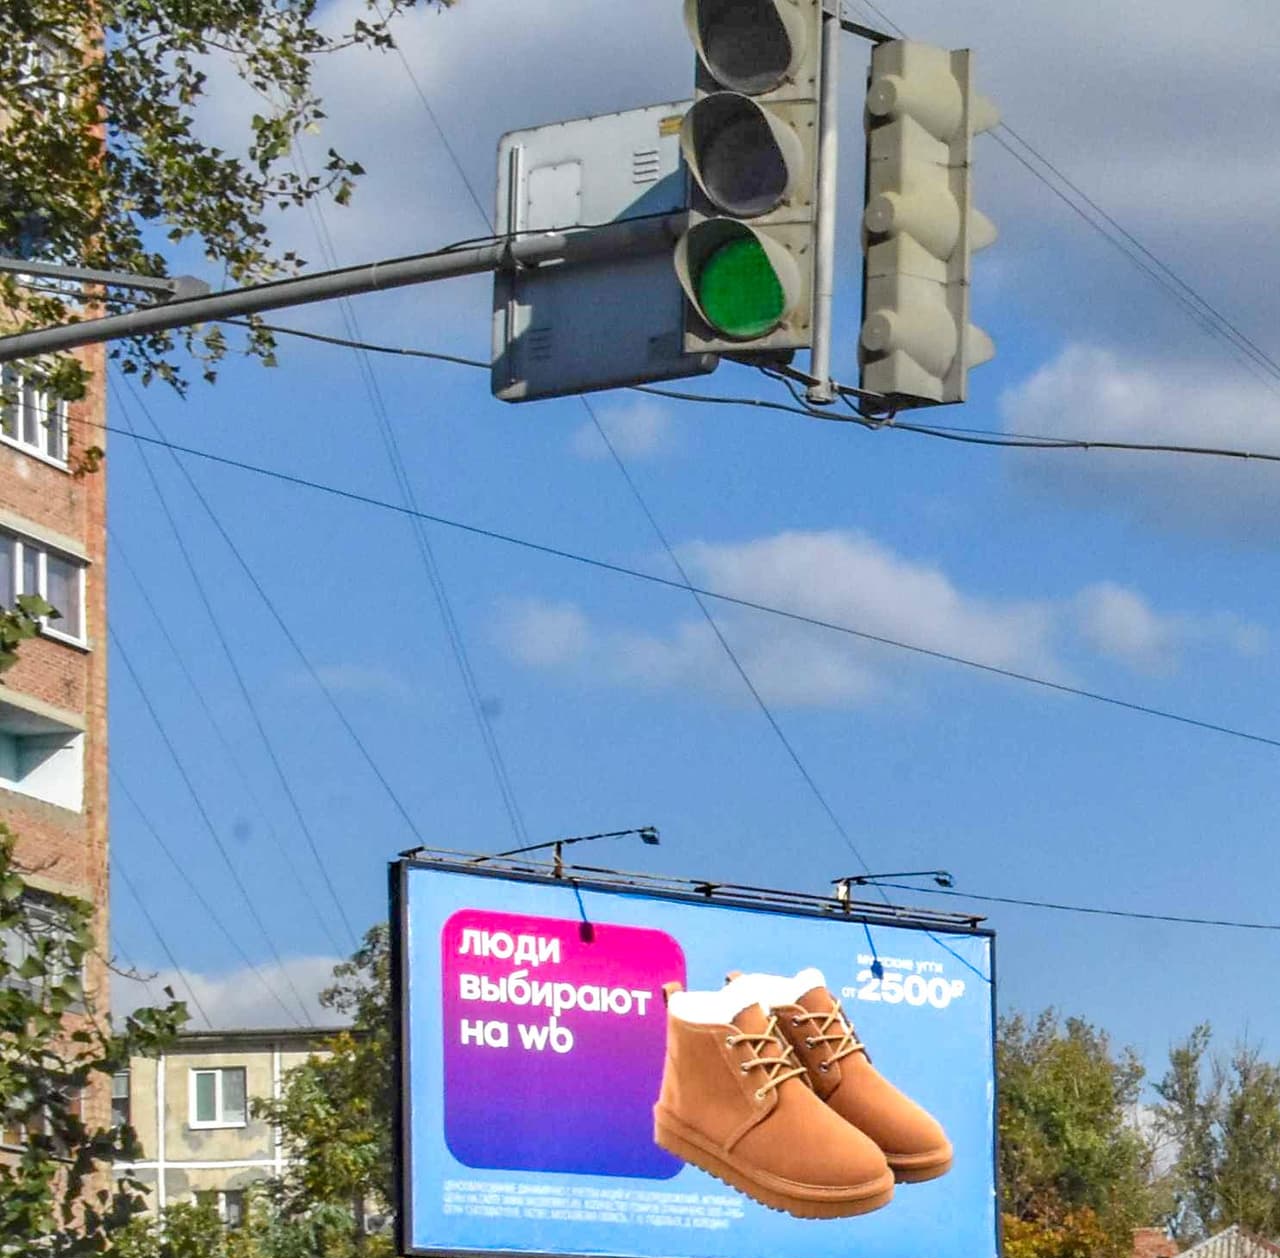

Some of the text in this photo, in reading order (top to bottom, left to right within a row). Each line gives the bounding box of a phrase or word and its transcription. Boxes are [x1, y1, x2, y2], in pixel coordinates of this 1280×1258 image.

[459, 929, 560, 967] люди
[459, 969, 652, 1016] выбирают
[460, 1016, 574, 1053] на wb
